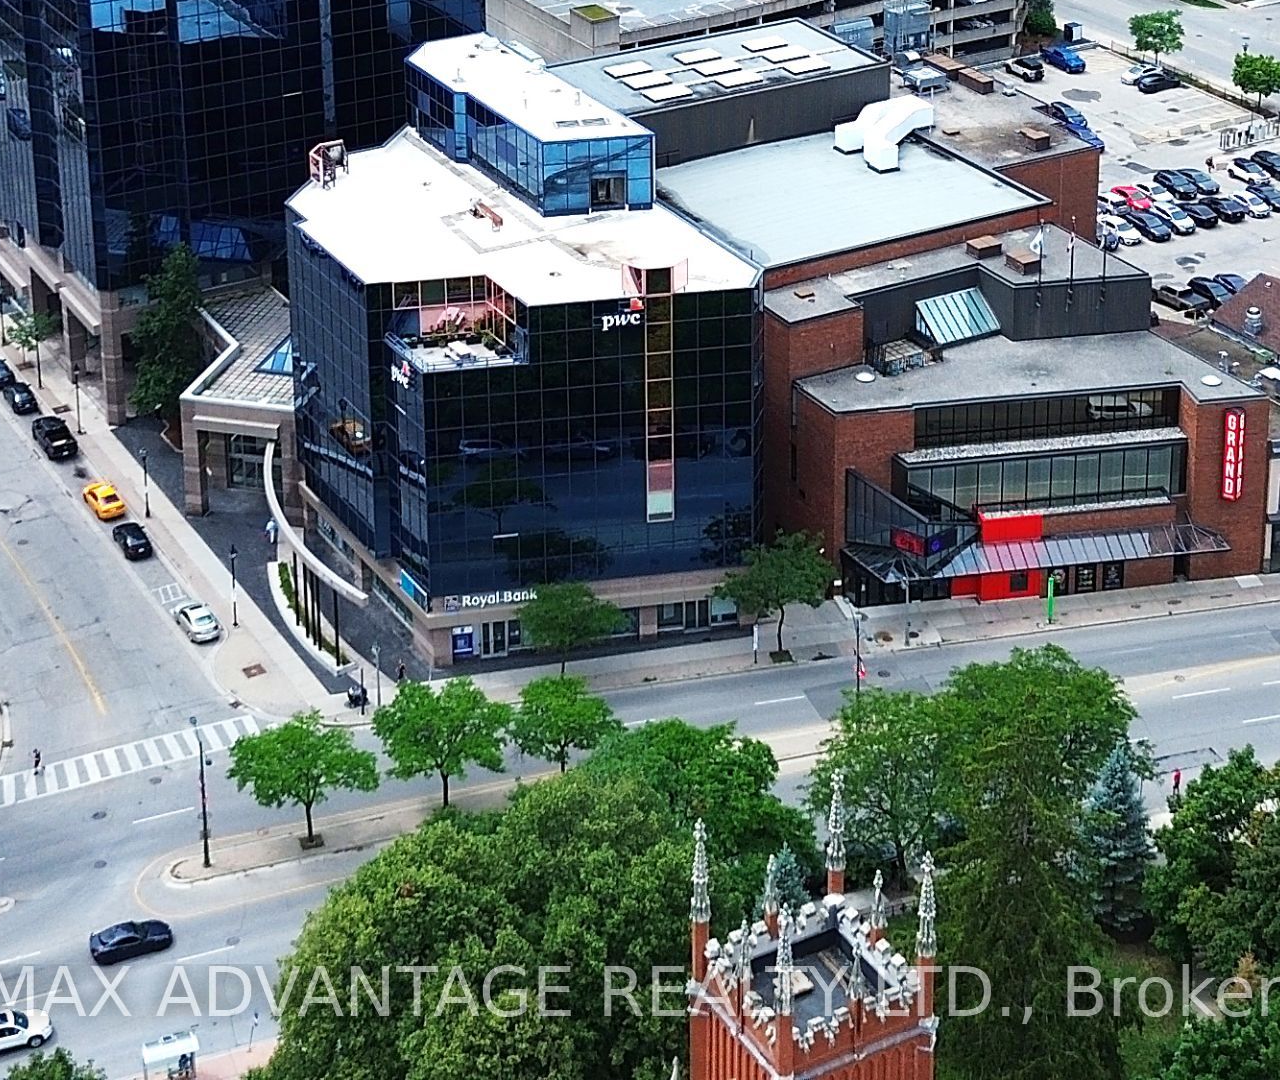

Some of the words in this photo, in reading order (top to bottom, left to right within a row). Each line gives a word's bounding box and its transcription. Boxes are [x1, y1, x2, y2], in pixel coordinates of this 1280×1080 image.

[601, 313, 641, 332] pwc
[1224, 414, 1237, 494] GRAND
[462, 591, 500, 608] Royal
[504, 588, 538, 602] Bank
